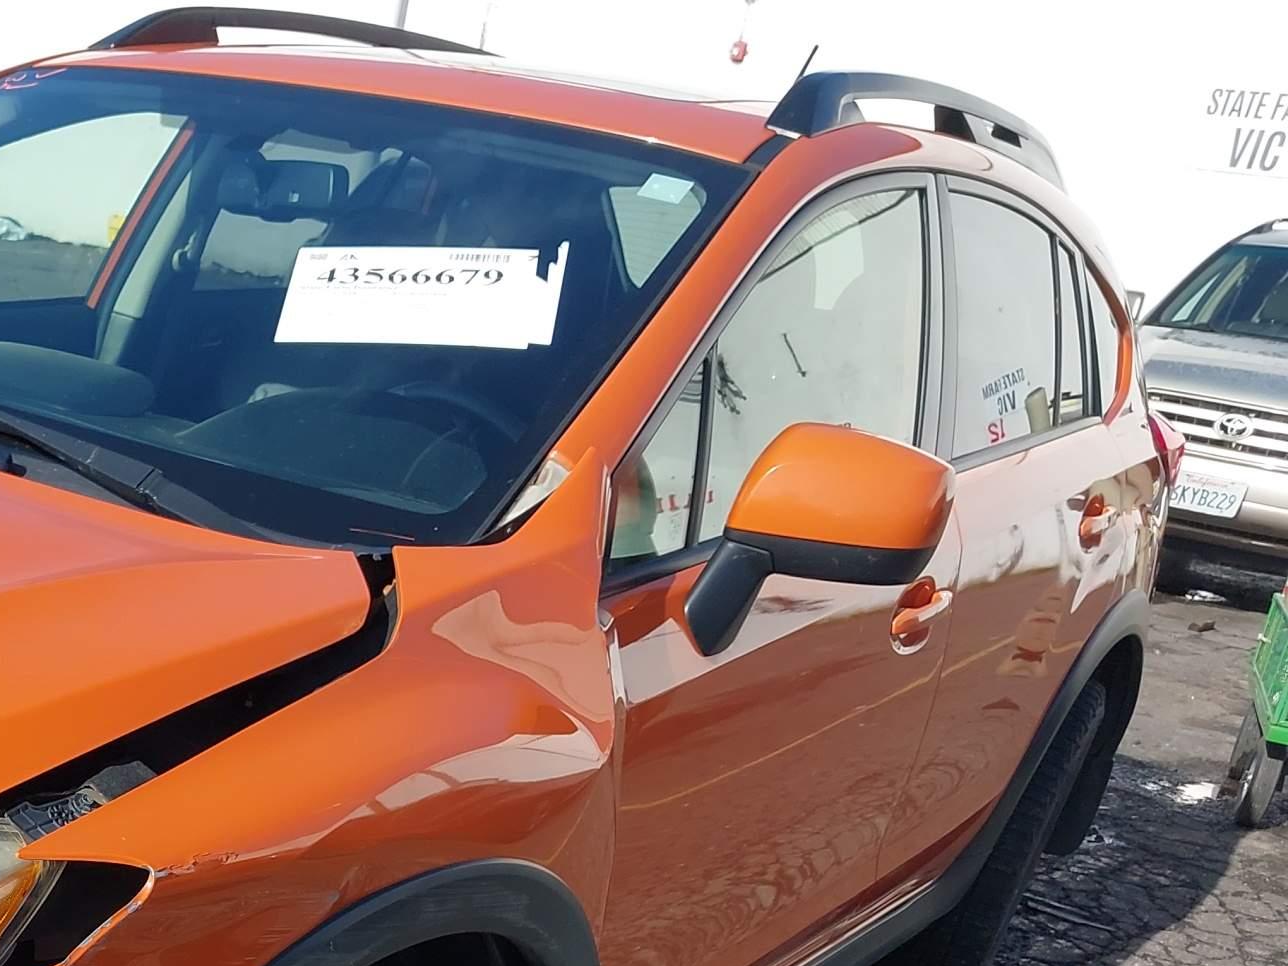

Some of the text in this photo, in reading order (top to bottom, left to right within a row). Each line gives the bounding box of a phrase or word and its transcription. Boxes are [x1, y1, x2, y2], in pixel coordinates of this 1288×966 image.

[1207, 88, 1271, 119] STATE
[1229, 127, 1287, 172] VIC
[316, 266, 504, 286] 43566679
